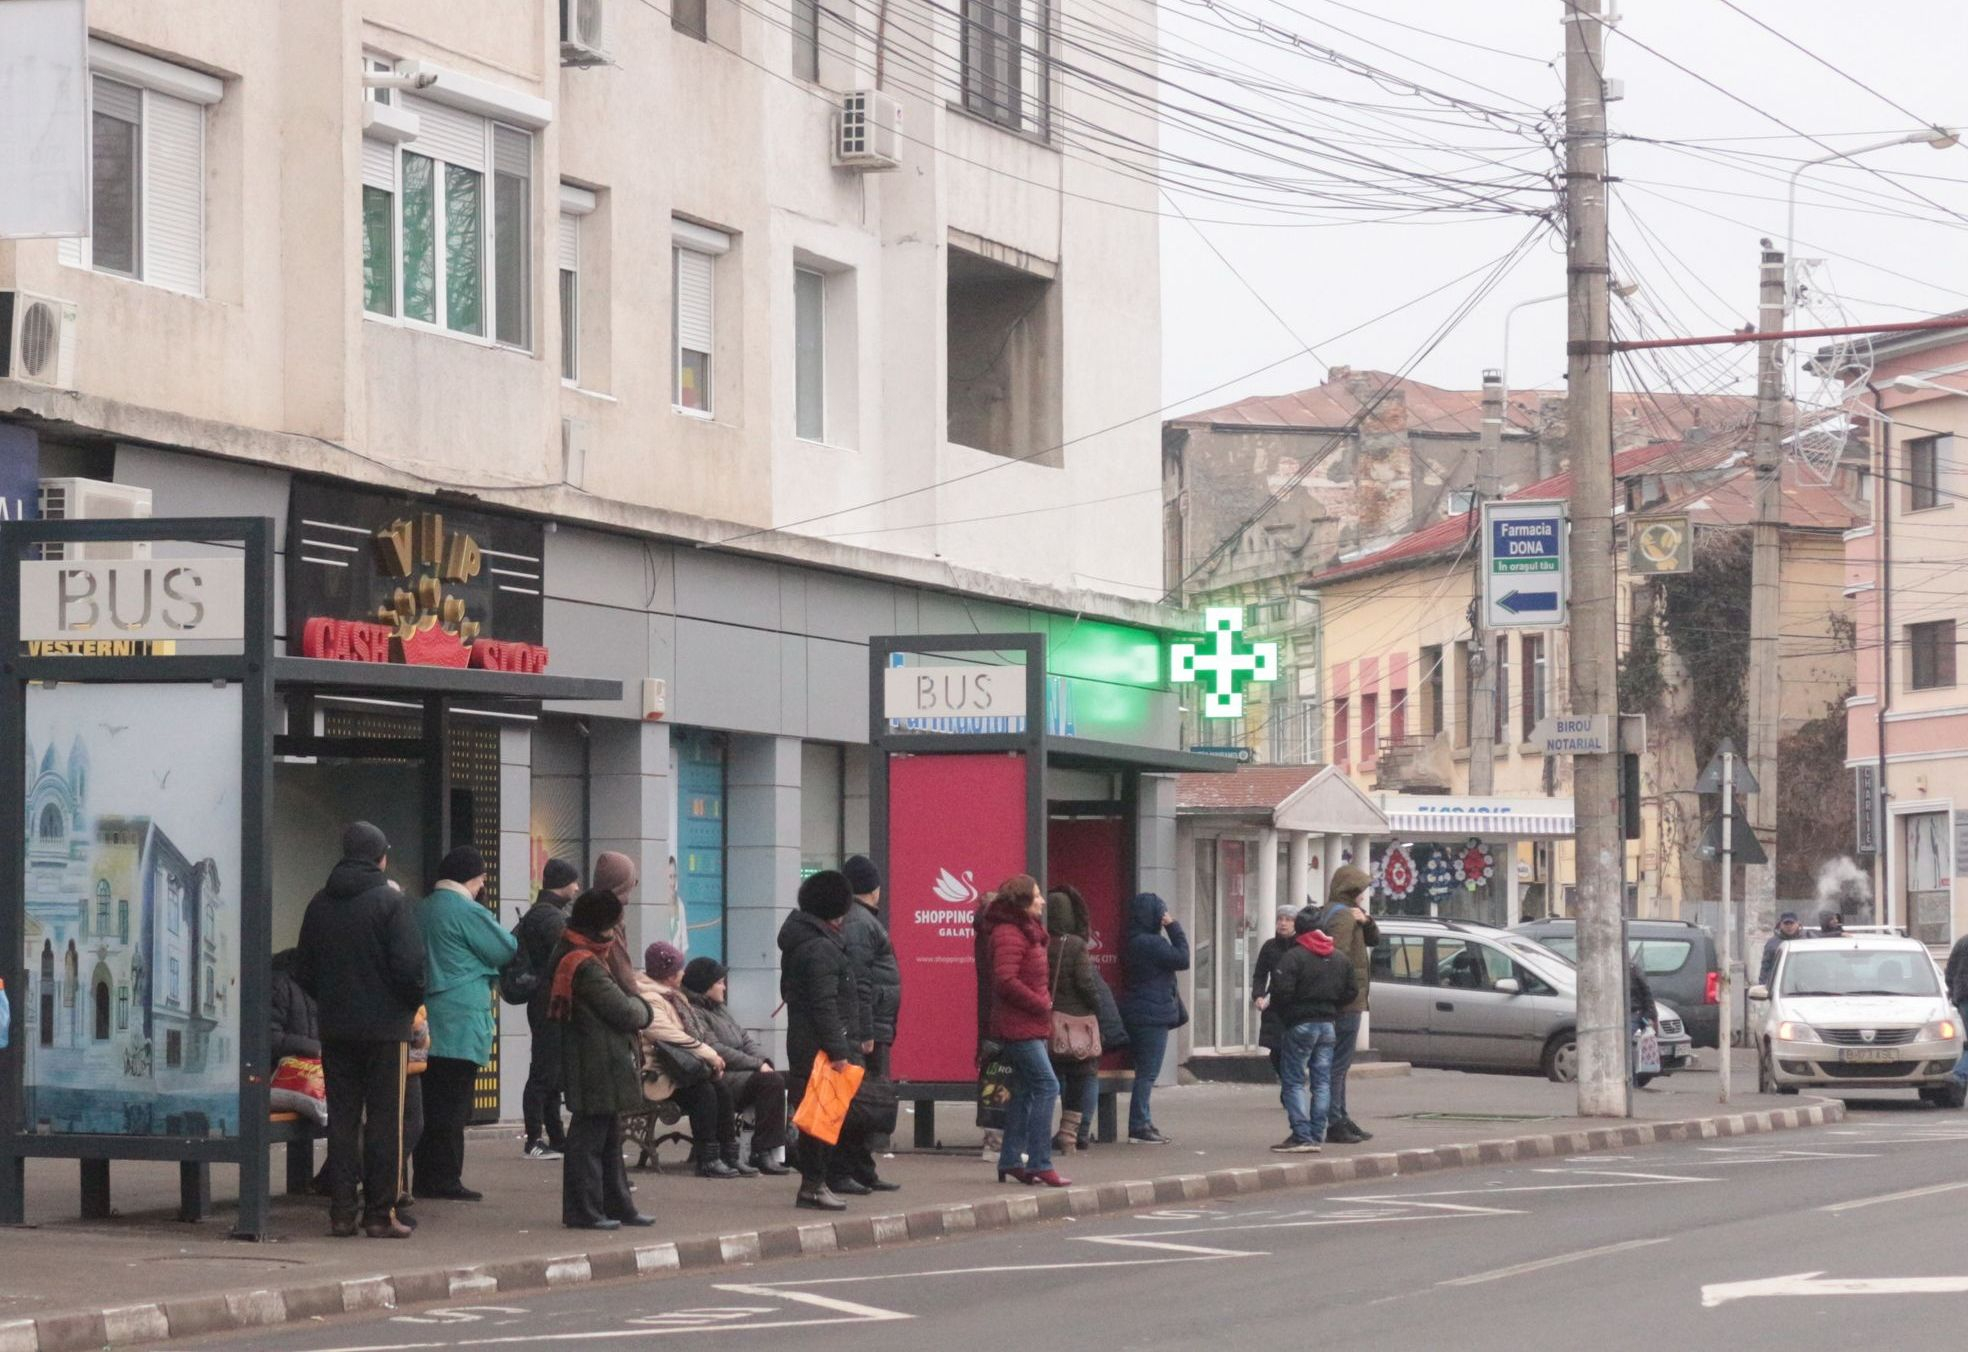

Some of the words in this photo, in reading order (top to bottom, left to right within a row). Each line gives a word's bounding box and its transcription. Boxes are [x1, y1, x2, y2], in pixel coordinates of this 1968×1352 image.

[1501, 522, 1552, 536] Farmacia
[377, 512, 481, 583] VIP
[1510, 540, 1544, 554] DONA
[58, 566, 204, 631] BUS
[303, 616, 391, 662] CASH
[471, 638, 548, 673] SLOT
[917, 673, 992, 710] BUS
[1557, 720, 1591, 732] BIROU
[1547, 738, 1601, 750] NOTARIAL
[1863, 767, 1872, 843] CHARLIE
[914, 910, 975, 923] SHOPPING
